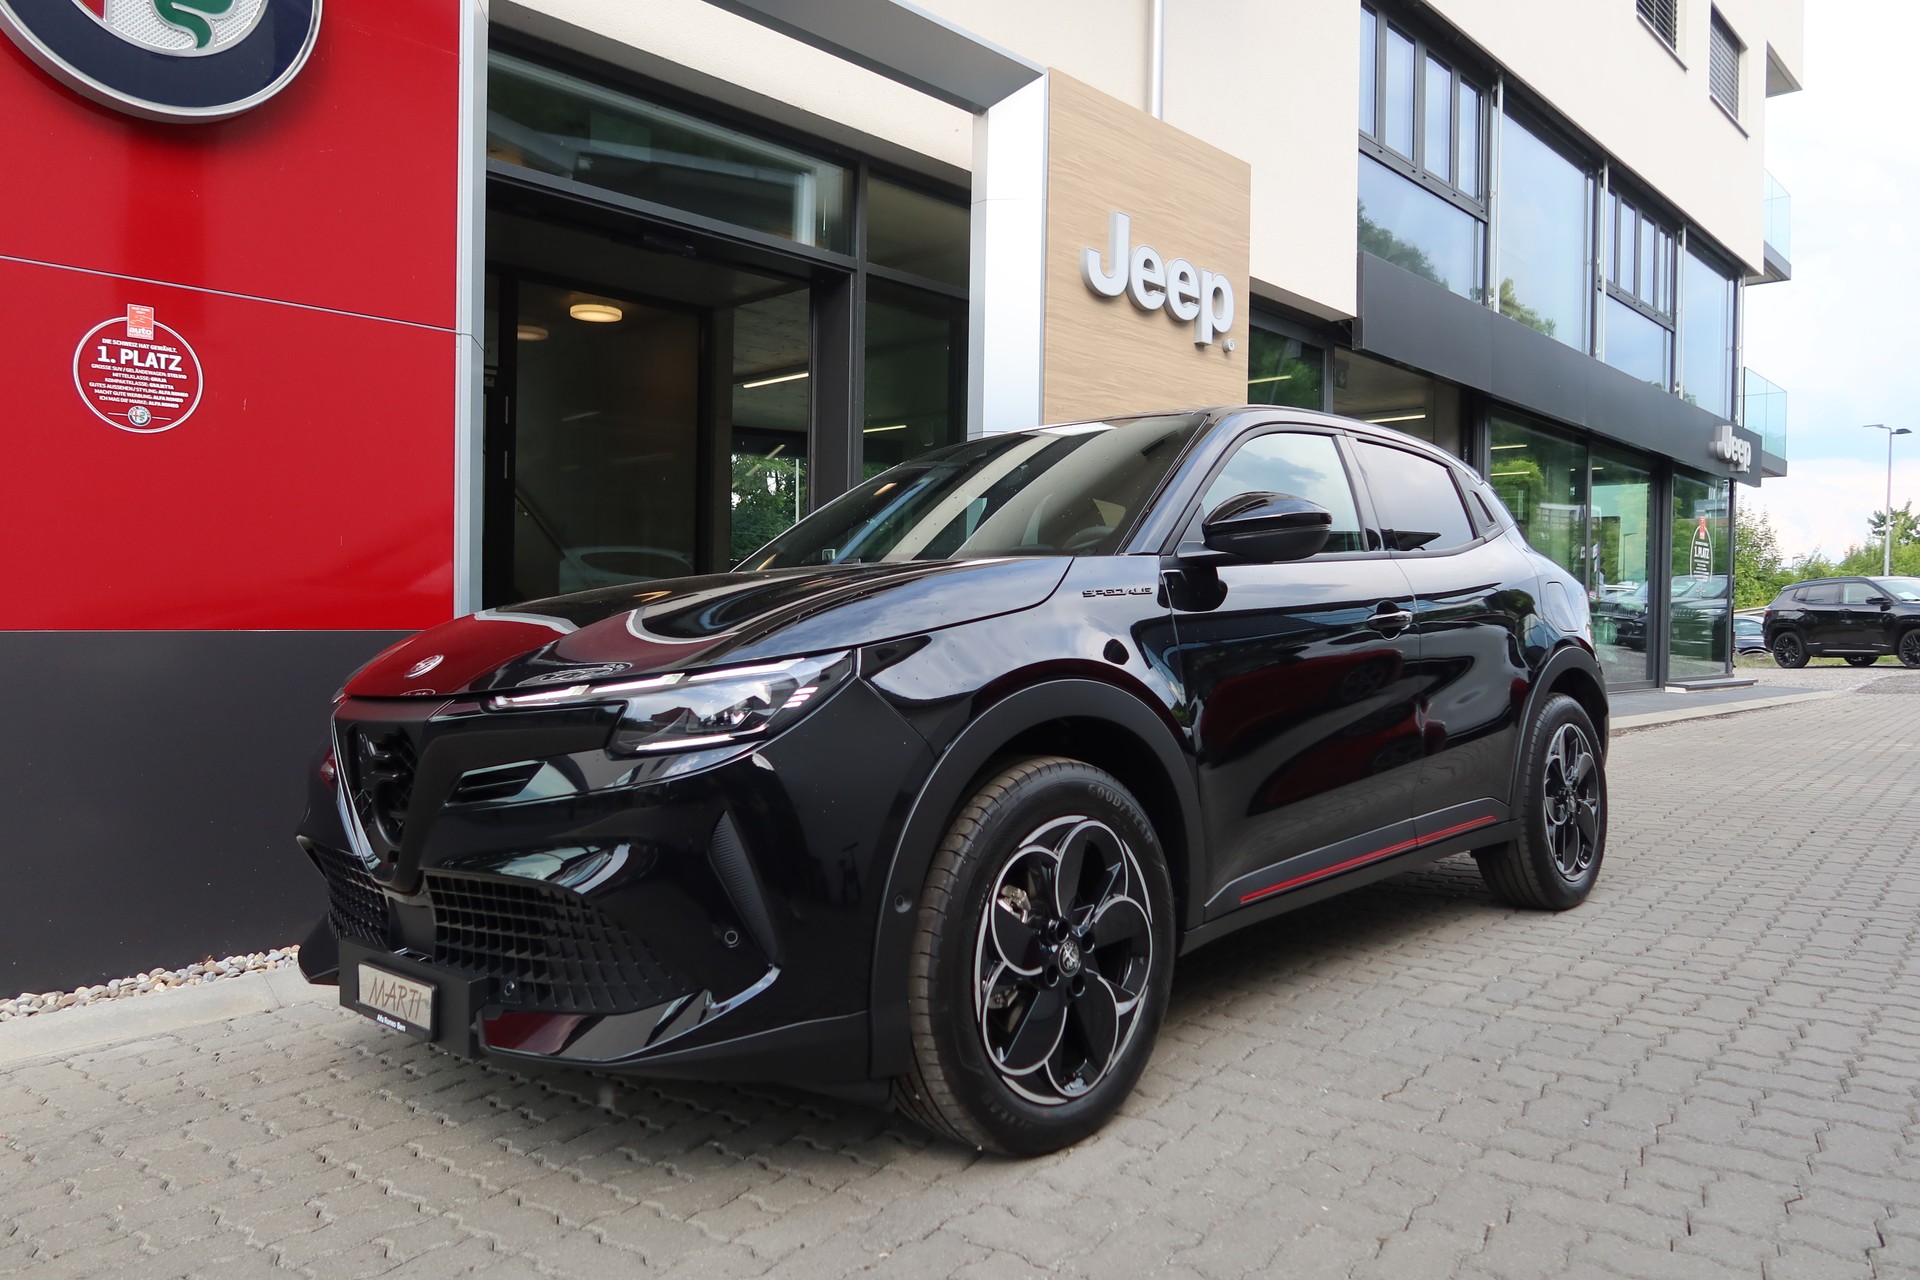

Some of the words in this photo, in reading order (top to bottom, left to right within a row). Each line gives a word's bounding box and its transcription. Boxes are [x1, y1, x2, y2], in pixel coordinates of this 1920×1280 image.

[1080, 211, 1234, 345] Jeep
[113, 339, 138, 348] SCHWEIZ
[129, 327, 151, 335] auto
[98, 346, 116, 363] 1.
[120, 348, 182, 372] PLATZ
[1714, 425, 1751, 472] Jeep
[1698, 546, 1709, 558] PLATZ
[368, 976, 422, 1021] MARTI
